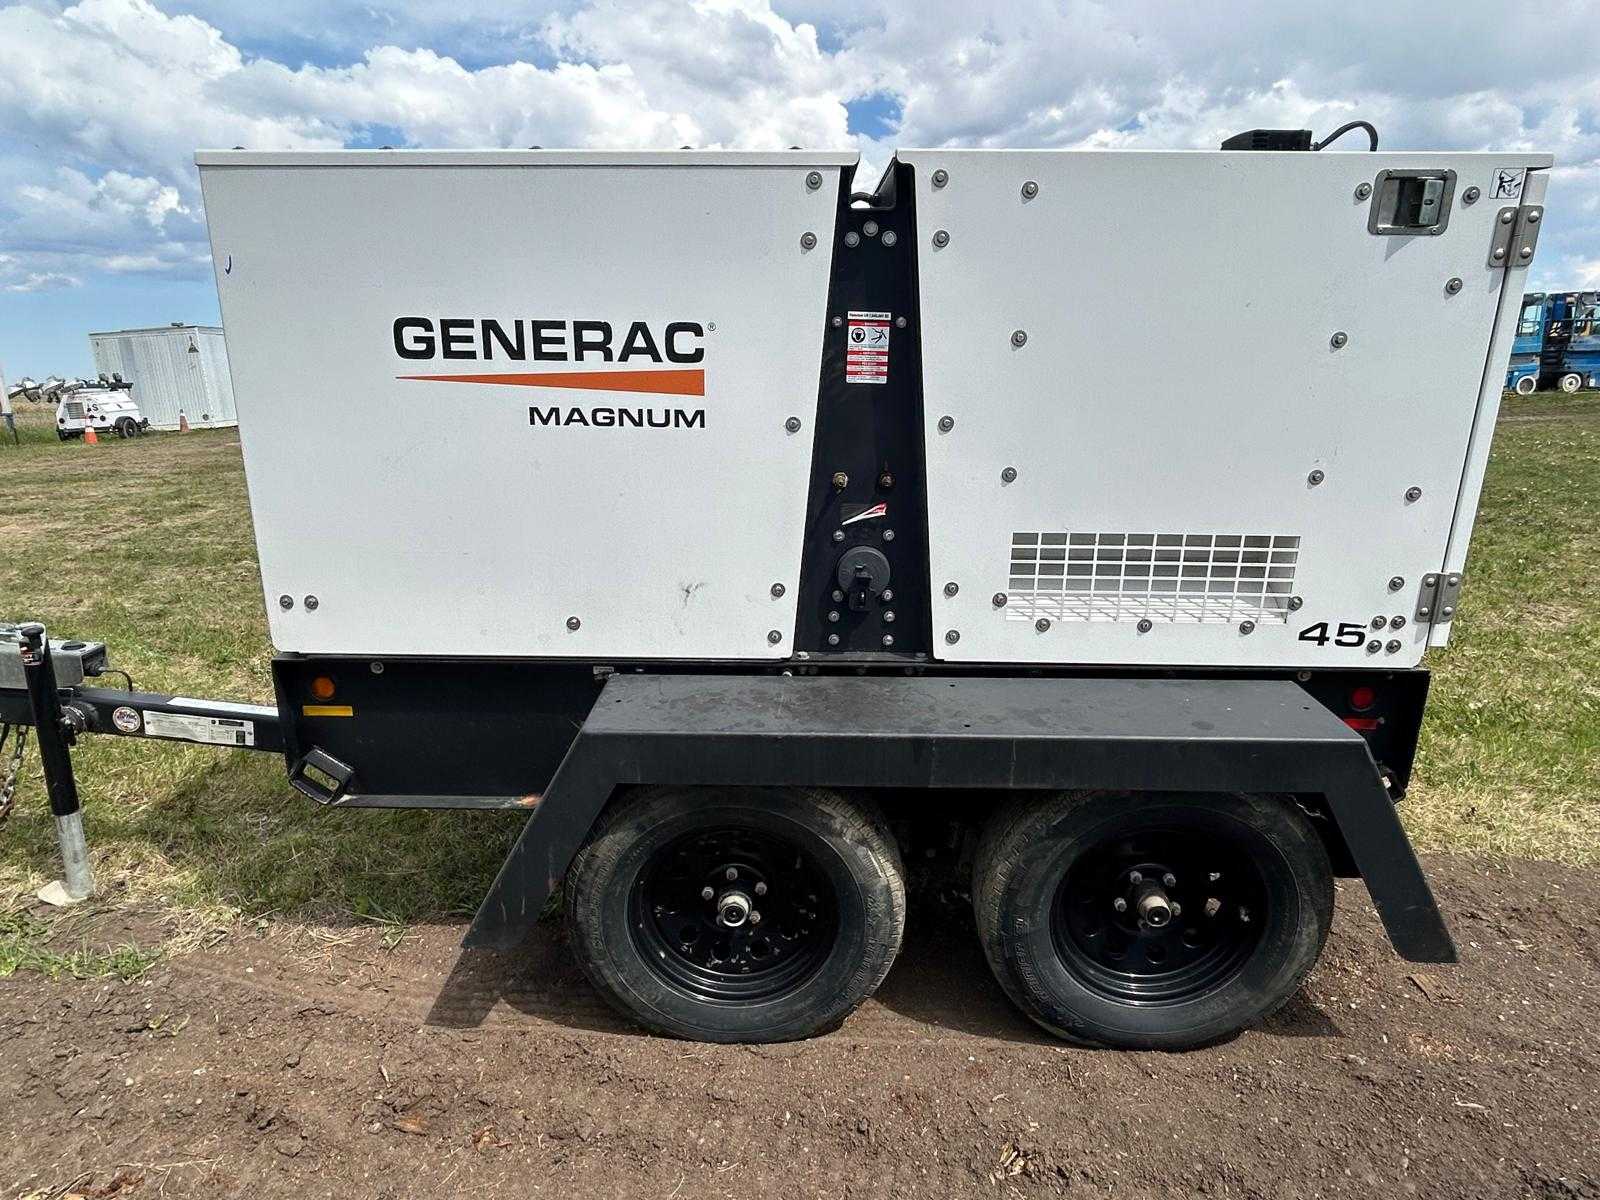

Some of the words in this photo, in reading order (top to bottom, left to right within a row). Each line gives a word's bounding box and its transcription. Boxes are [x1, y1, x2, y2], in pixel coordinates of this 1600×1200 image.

[393, 317, 705, 363] GENERAC
[529, 406, 706, 428] MAGNUM
[1298, 622, 1367, 647] 45
